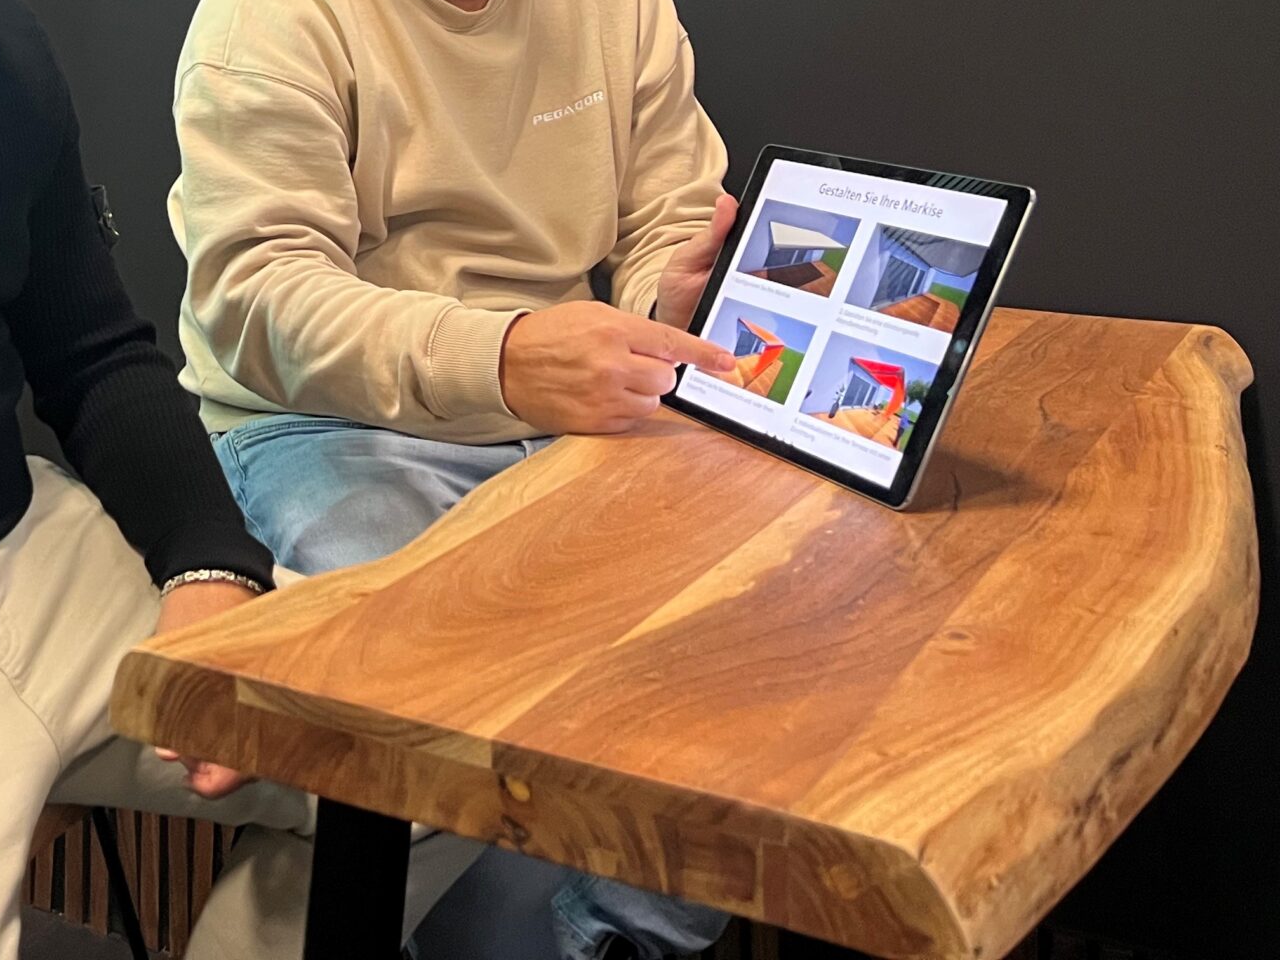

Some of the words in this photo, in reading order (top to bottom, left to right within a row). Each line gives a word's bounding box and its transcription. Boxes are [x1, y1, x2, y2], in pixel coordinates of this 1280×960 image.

[818, 183, 862, 202] Gestalten
[862, 191, 878, 205] Sie
[879, 194, 900, 210] Ihre
[901, 198, 944, 218] Markise
